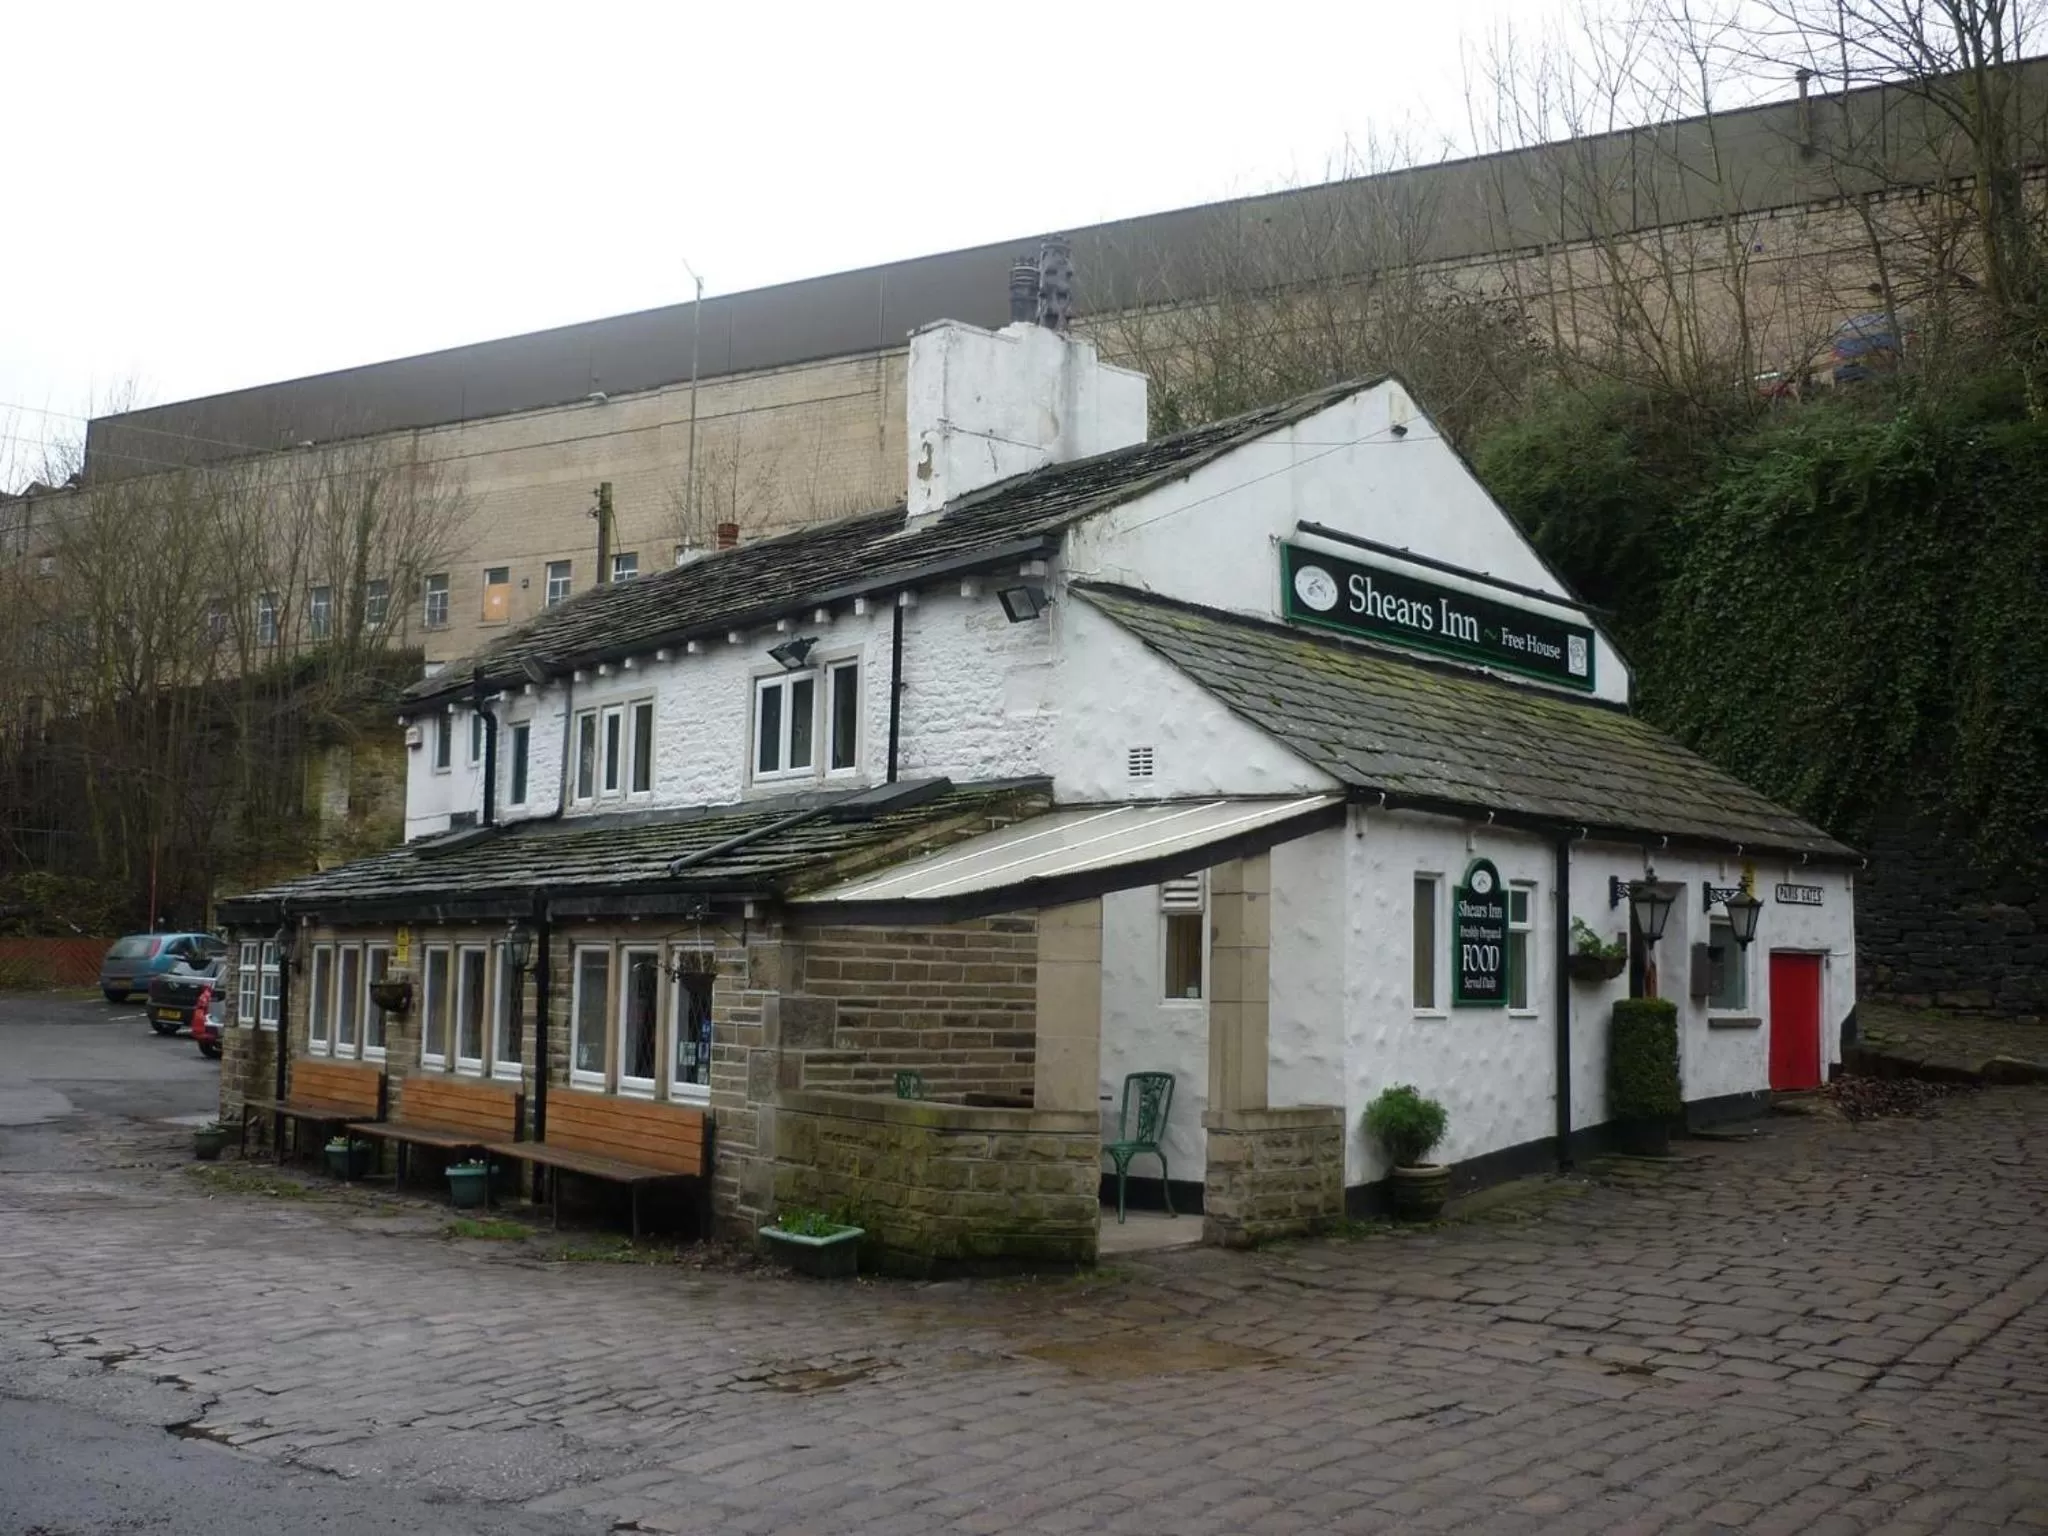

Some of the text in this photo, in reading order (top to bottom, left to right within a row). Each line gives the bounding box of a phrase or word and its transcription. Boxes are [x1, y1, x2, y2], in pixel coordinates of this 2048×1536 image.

[1349, 574, 1433, 630] Shears
[1439, 597, 1480, 643] Inn
[1501, 627, 1560, 659] Free House
[1459, 900, 1503, 918] Shears Inn
[1462, 944, 1500, 972] FOOD
